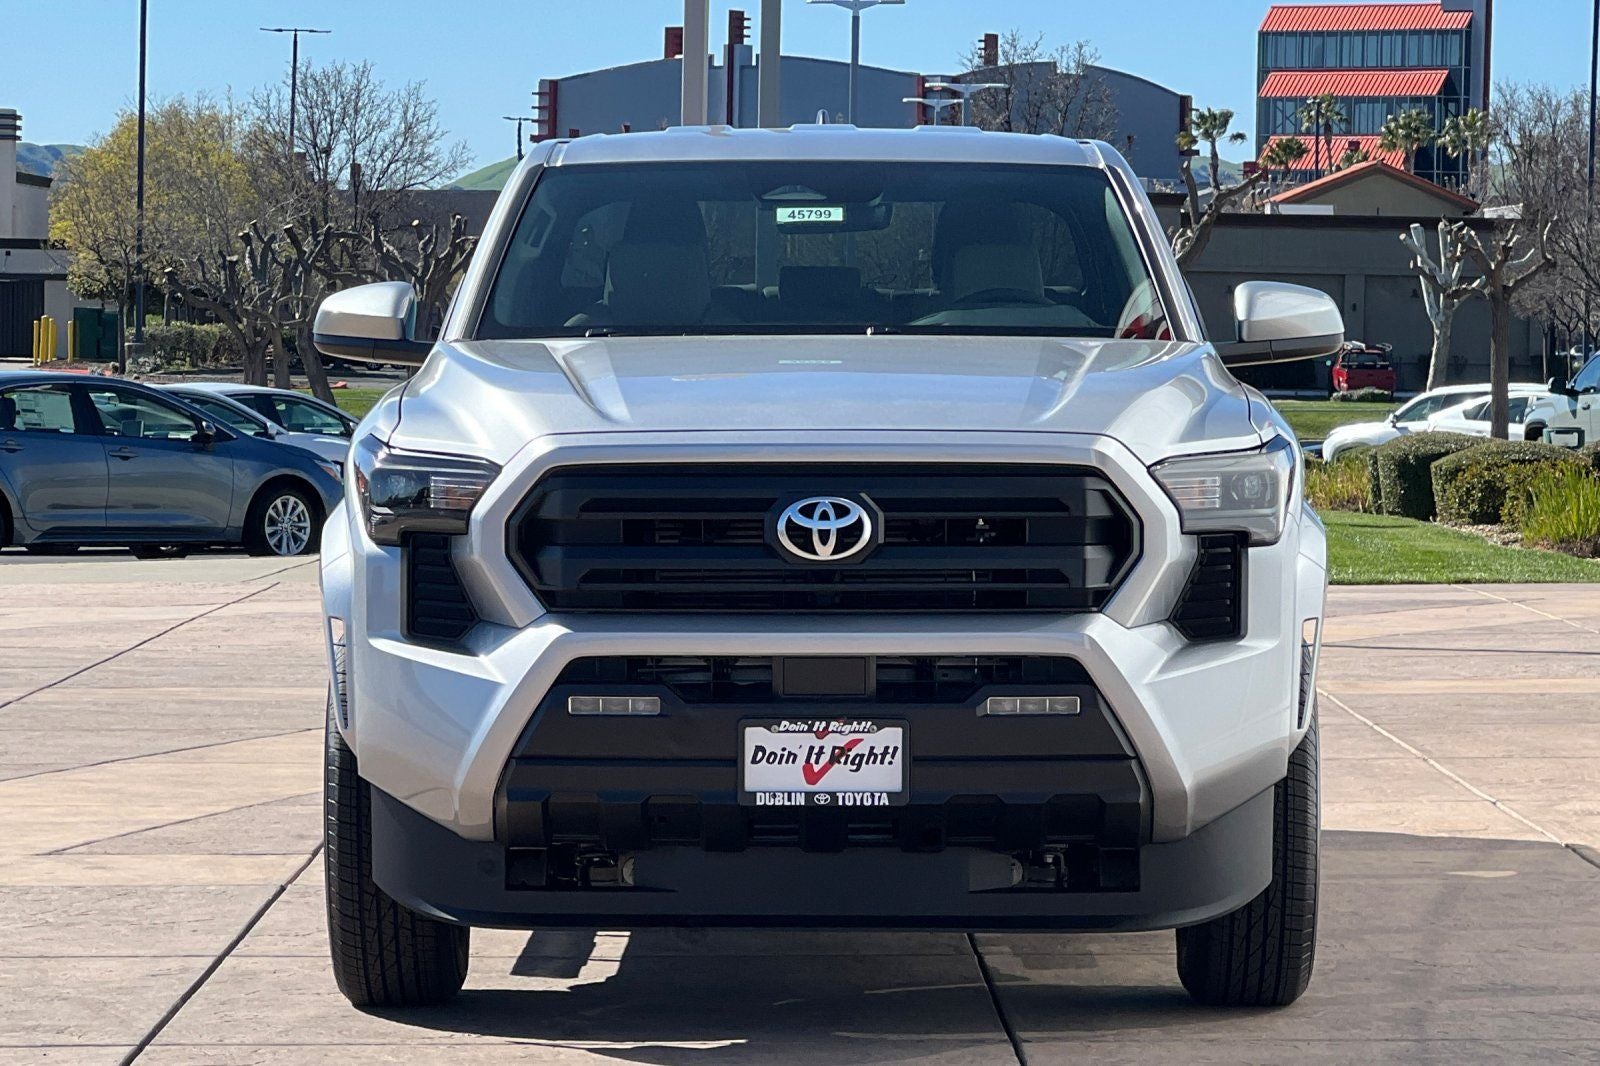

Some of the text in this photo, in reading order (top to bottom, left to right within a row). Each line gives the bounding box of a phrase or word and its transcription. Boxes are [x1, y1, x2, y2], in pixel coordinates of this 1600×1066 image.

[788, 209, 832, 220] 45799
[779, 720, 872, 735] Doin' It Right!
[805, 745, 825, 765] It
[828, 745, 899, 773] Right!
[756, 792, 889, 806] DUBLIN TOYOTA
